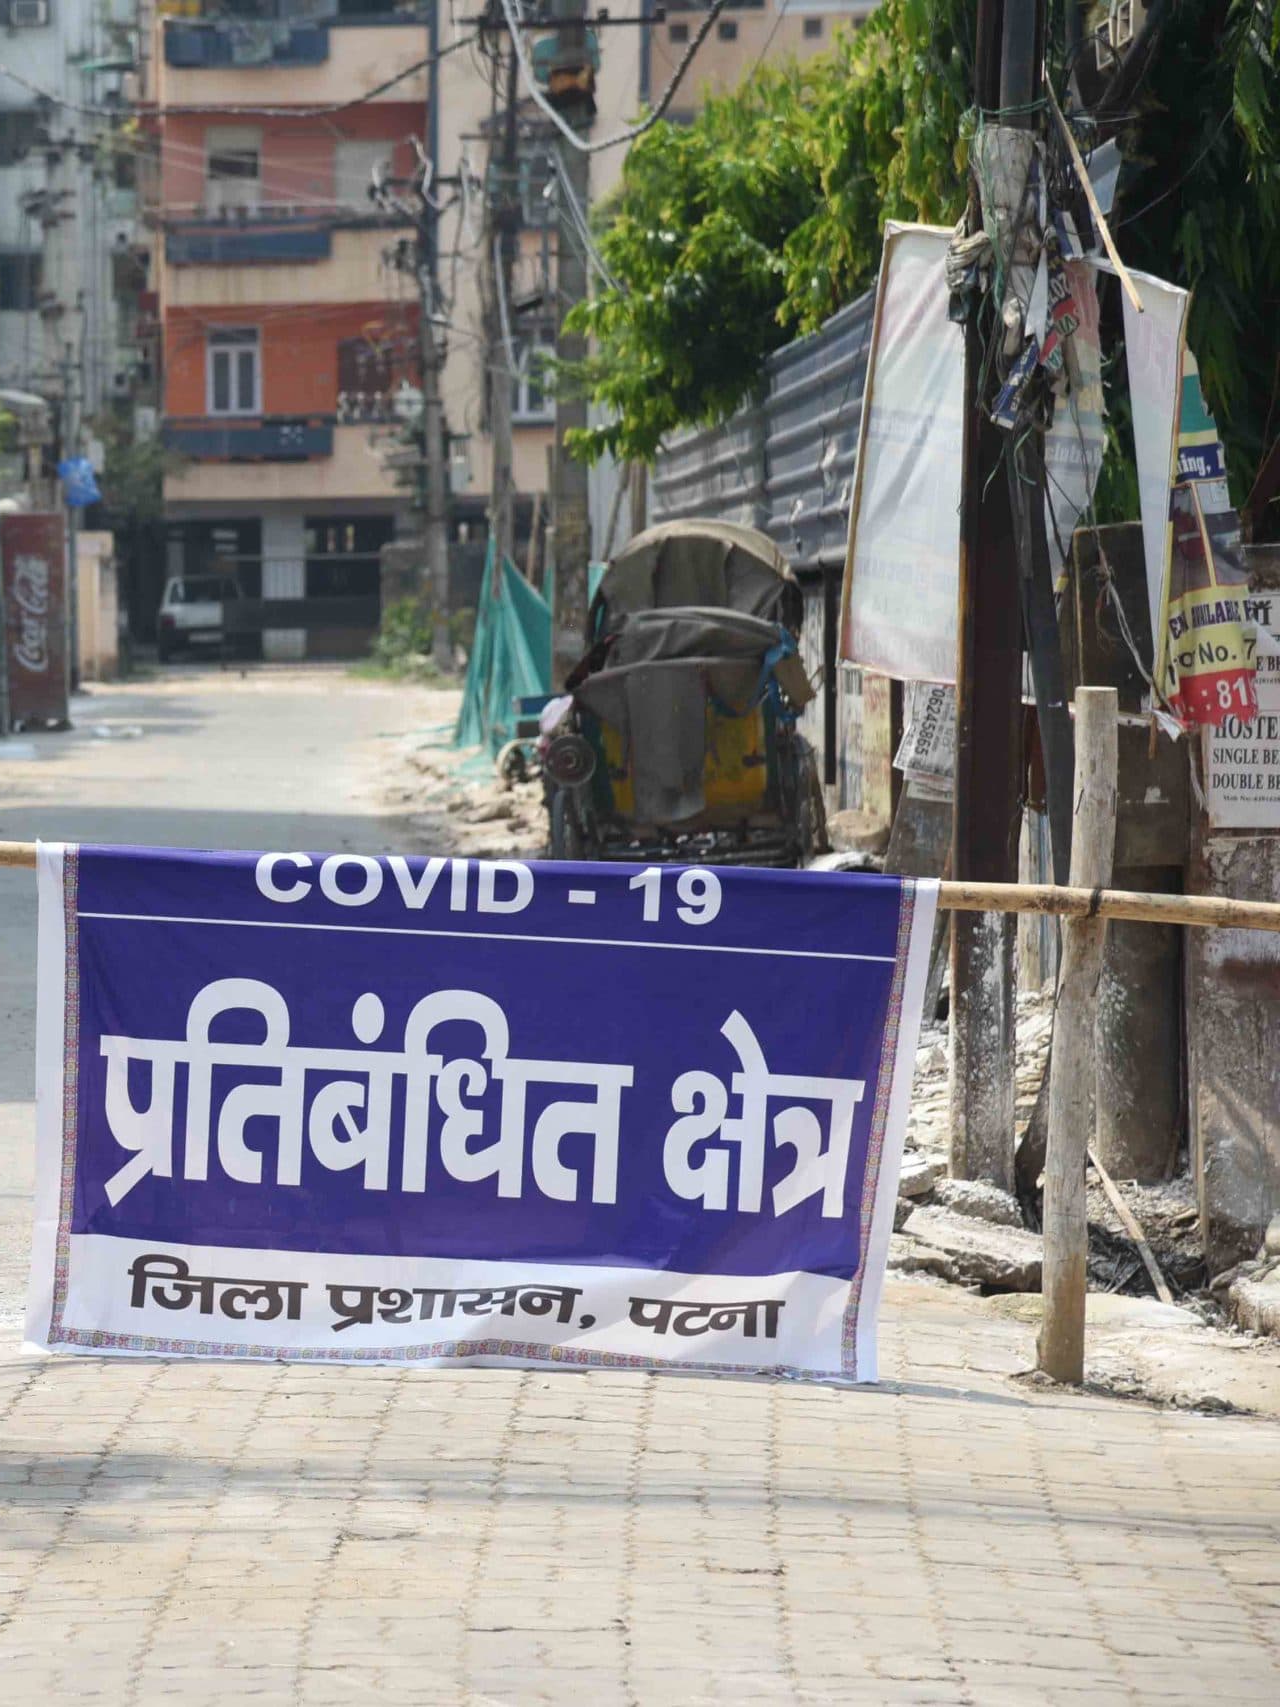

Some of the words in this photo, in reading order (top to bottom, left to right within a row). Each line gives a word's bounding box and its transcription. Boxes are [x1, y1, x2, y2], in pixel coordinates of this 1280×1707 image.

[1214, 714, 1280, 740] HOSTE
[1212, 748, 1259, 765] SINGLE
[1212, 772, 1264, 790] DOUBLE
[256, 853, 534, 914] COVID
[629, 866, 722, 925] 19
[100, 978, 634, 1207] प्रतिबंधित
[663, 1009, 866, 1219] क्षेत्र
[128, 1254, 309, 1321] जिला
[326, 1282, 595, 1332] प्रशासन,
[628, 1296, 786, 1339] पटना
